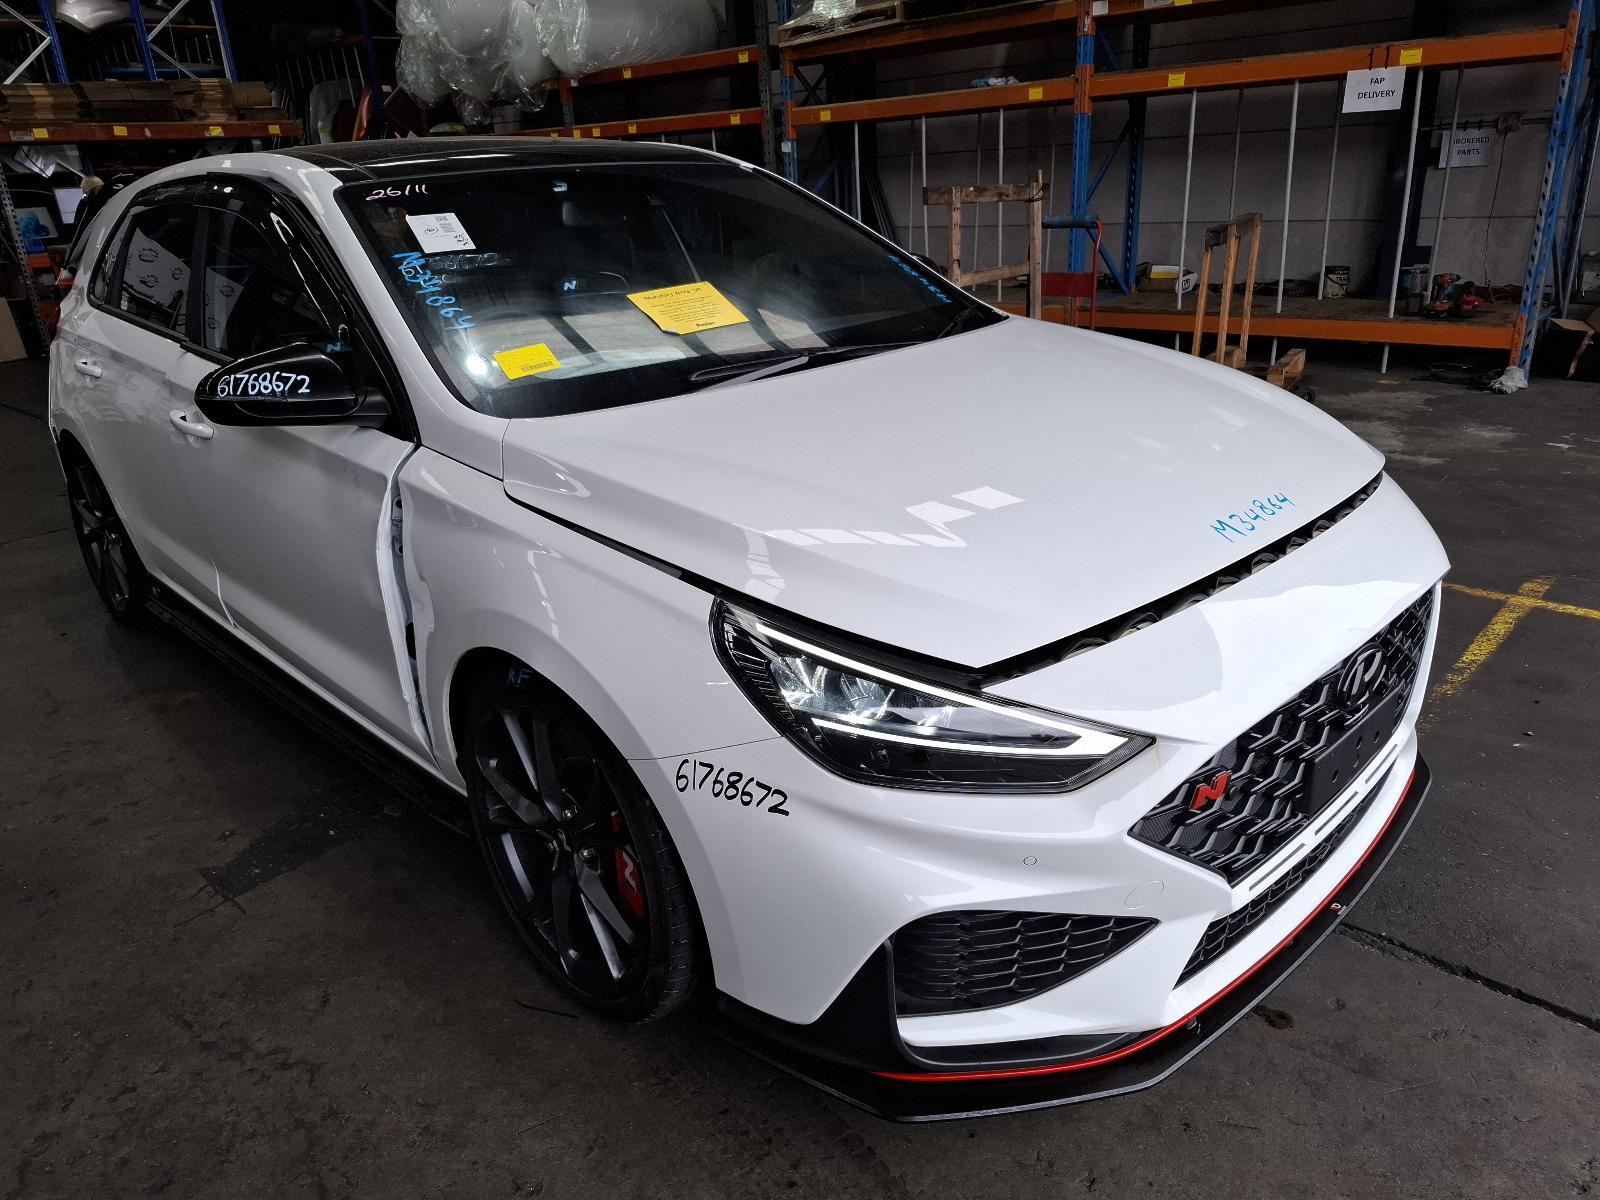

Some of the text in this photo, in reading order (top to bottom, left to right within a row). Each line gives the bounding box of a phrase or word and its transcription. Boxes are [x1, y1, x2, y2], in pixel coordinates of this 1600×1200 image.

[1369, 77, 1385, 86] FAP
[1357, 89, 1396, 99] DELIVERY
[1457, 148, 1480, 156] PARTS
[366, 184, 429, 200] 26/11
[217, 371, 310, 396] 61768672
[1210, 492, 1296, 543] M34864
[675, 758, 790, 816] 61768672
[1189, 770, 1232, 811] N
